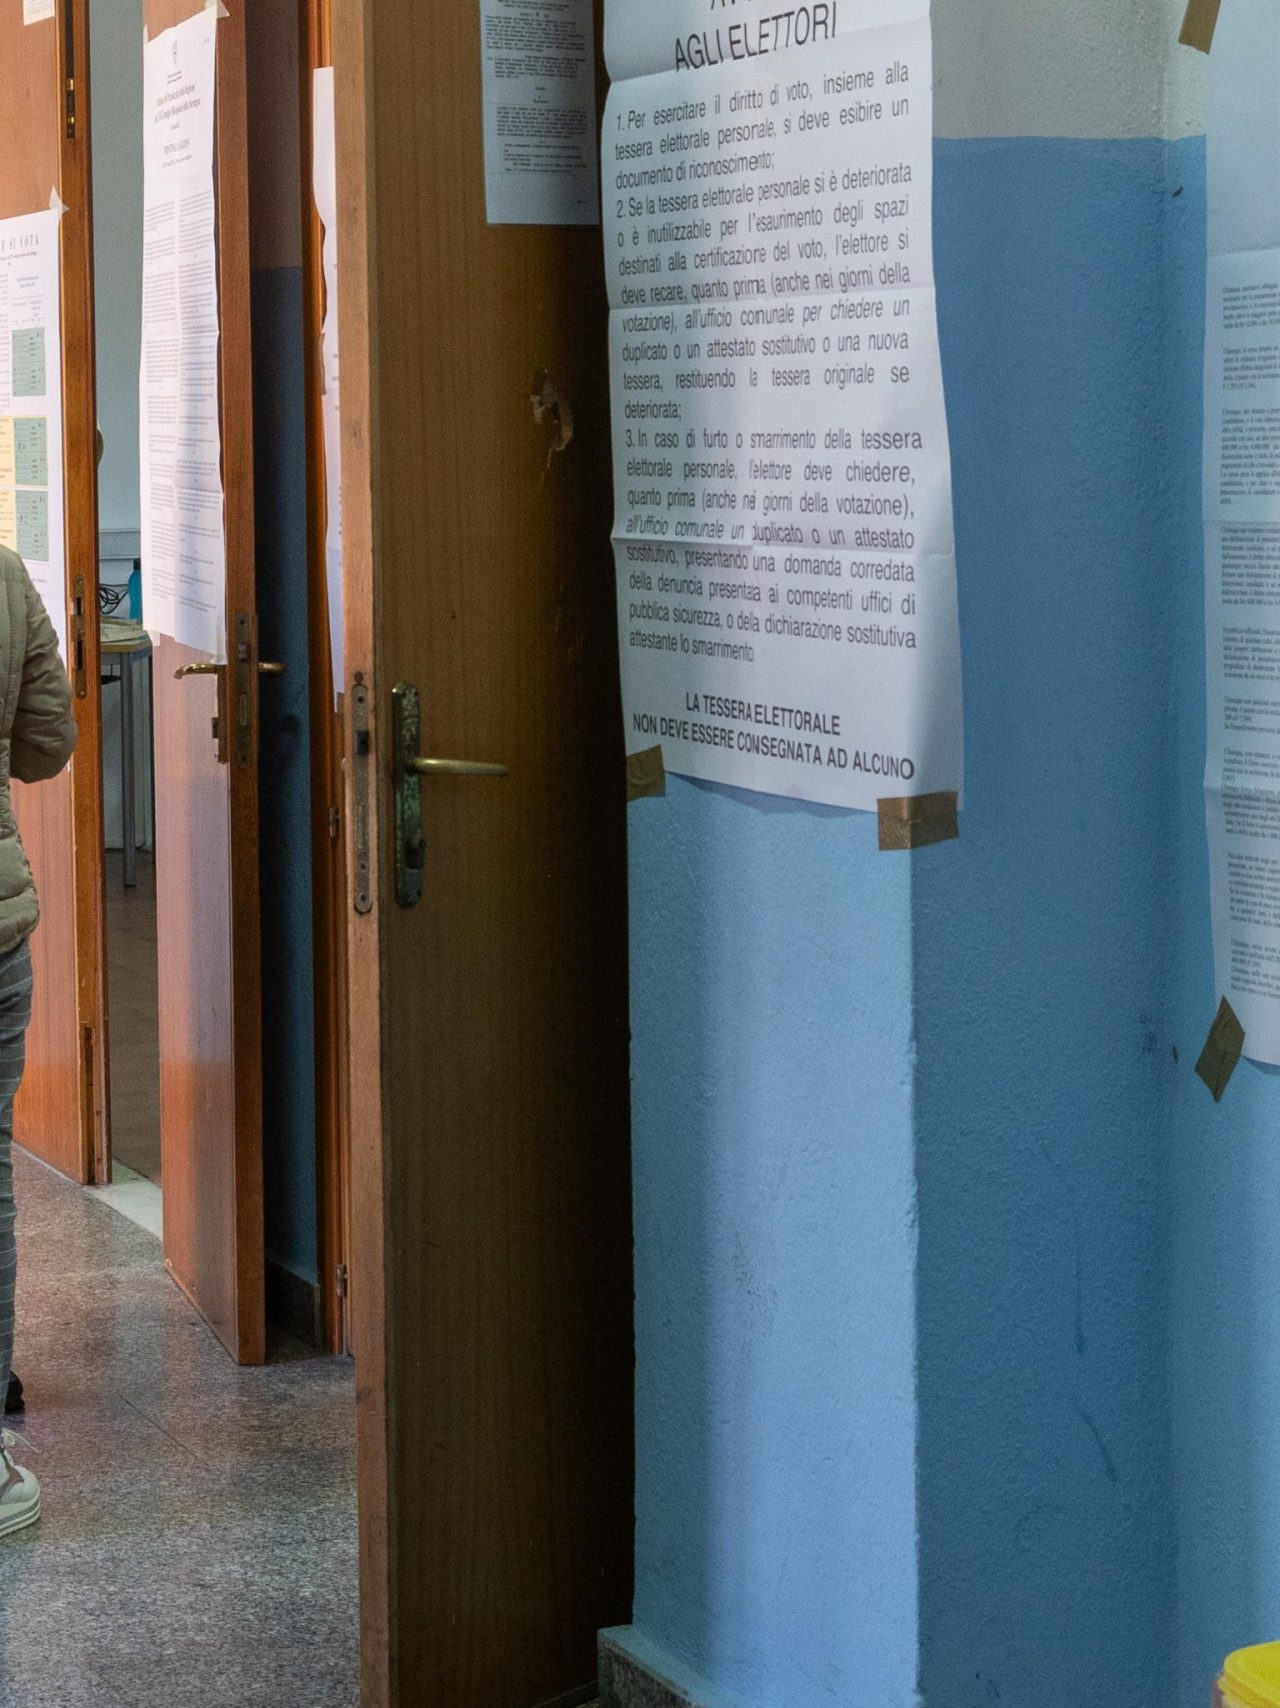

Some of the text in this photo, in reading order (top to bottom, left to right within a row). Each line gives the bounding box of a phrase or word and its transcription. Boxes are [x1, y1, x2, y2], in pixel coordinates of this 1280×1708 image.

[674, 1, 837, 73] AGLI ELETTORI
[617, 61, 908, 131] 1. Per esercitare il diritto di voto, insieme alla
[615, 141, 652, 160] tessera
[660, 130, 710, 153] elettorale
[784, 116, 791, 134] si
[798, 110, 829, 132] deve
[839, 101, 881, 125] esibire
[892, 97, 909, 116] un
[616, 167, 672, 190] documento
[676, 164, 686, 181] di
[617, 164, 911, 218] 2. Se la tessera elettorale personale si è deteriorata
[618, 230, 624, 247] o
[633, 224, 639, 244] è
[648, 219, 711, 244] inutilizzabile
[720, 217, 737, 240] per
[834, 201, 863, 227] degli
[874, 194, 909, 219] spazi
[620, 254, 661, 276] destinati
[668, 251, 686, 271] alla
[694, 245, 766, 269] certificazione
[773, 241, 790, 260] del
[798, 241, 827, 260] voto,
[898, 228, 909, 249] si
[622, 285, 646, 304] deve
[692, 277, 728, 299] quanto
[734, 276, 766, 299] prima
[771, 273, 809, 296] (anche
[839, 265, 873, 292] giorni
[879, 262, 910, 285] della
[740, 302, 794, 323] comunale
[803, 300, 821, 322] per
[830, 299, 883, 319] chiedere
[893, 298, 910, 316] un
[623, 331, 908, 364] duplicato o un attestato sostitutivo o una nuova
[624, 362, 909, 391] tessera, restituendo la tessera originale se
[625, 428, 922, 448] 3. In caso di furto o smarrimento della tessera
[627, 459, 672, 477] elettorale
[804, 460, 832, 480] deve
[846, 461, 915, 485] chiedere,
[627, 489, 661, 510] quanto
[667, 489, 695, 510] prima
[702, 488, 736, 511] (anche
[763, 491, 792, 515] giorni
[800, 493, 828, 512] della
[675, 519, 724, 538] comunale
[731, 524, 744, 539] un
[752, 524, 803, 543] duplicato
[812, 527, 820, 543] o
[829, 528, 845, 545] un
[855, 527, 914, 548] attestato
[686, 548, 747, 574] presentando
[753, 554, 775, 572] una
[784, 554, 841, 576] domanda
[850, 559, 915, 582] corredata
[629, 571, 651, 590] della
[658, 574, 702, 595] denuncia
[769, 583, 779, 602] ai
[787, 587, 852, 615] competenti
[861, 590, 892, 613] uffici
[901, 594, 915, 615] di
[629, 600, 669, 624] pubblica
[727, 612, 733, 629] o
[737, 609, 760, 632] della
[764, 613, 841, 641] dichiarazione
[847, 621, 917, 649] sostitutiva
[629, 628, 677, 652] attestante
[680, 632, 689, 653] lo
[686, 692, 840, 736] LA TESSERA ELETTORALE
[633, 713, 914, 780] NON DEVE ESSERE CONSEGNATA AD ALCUNO
